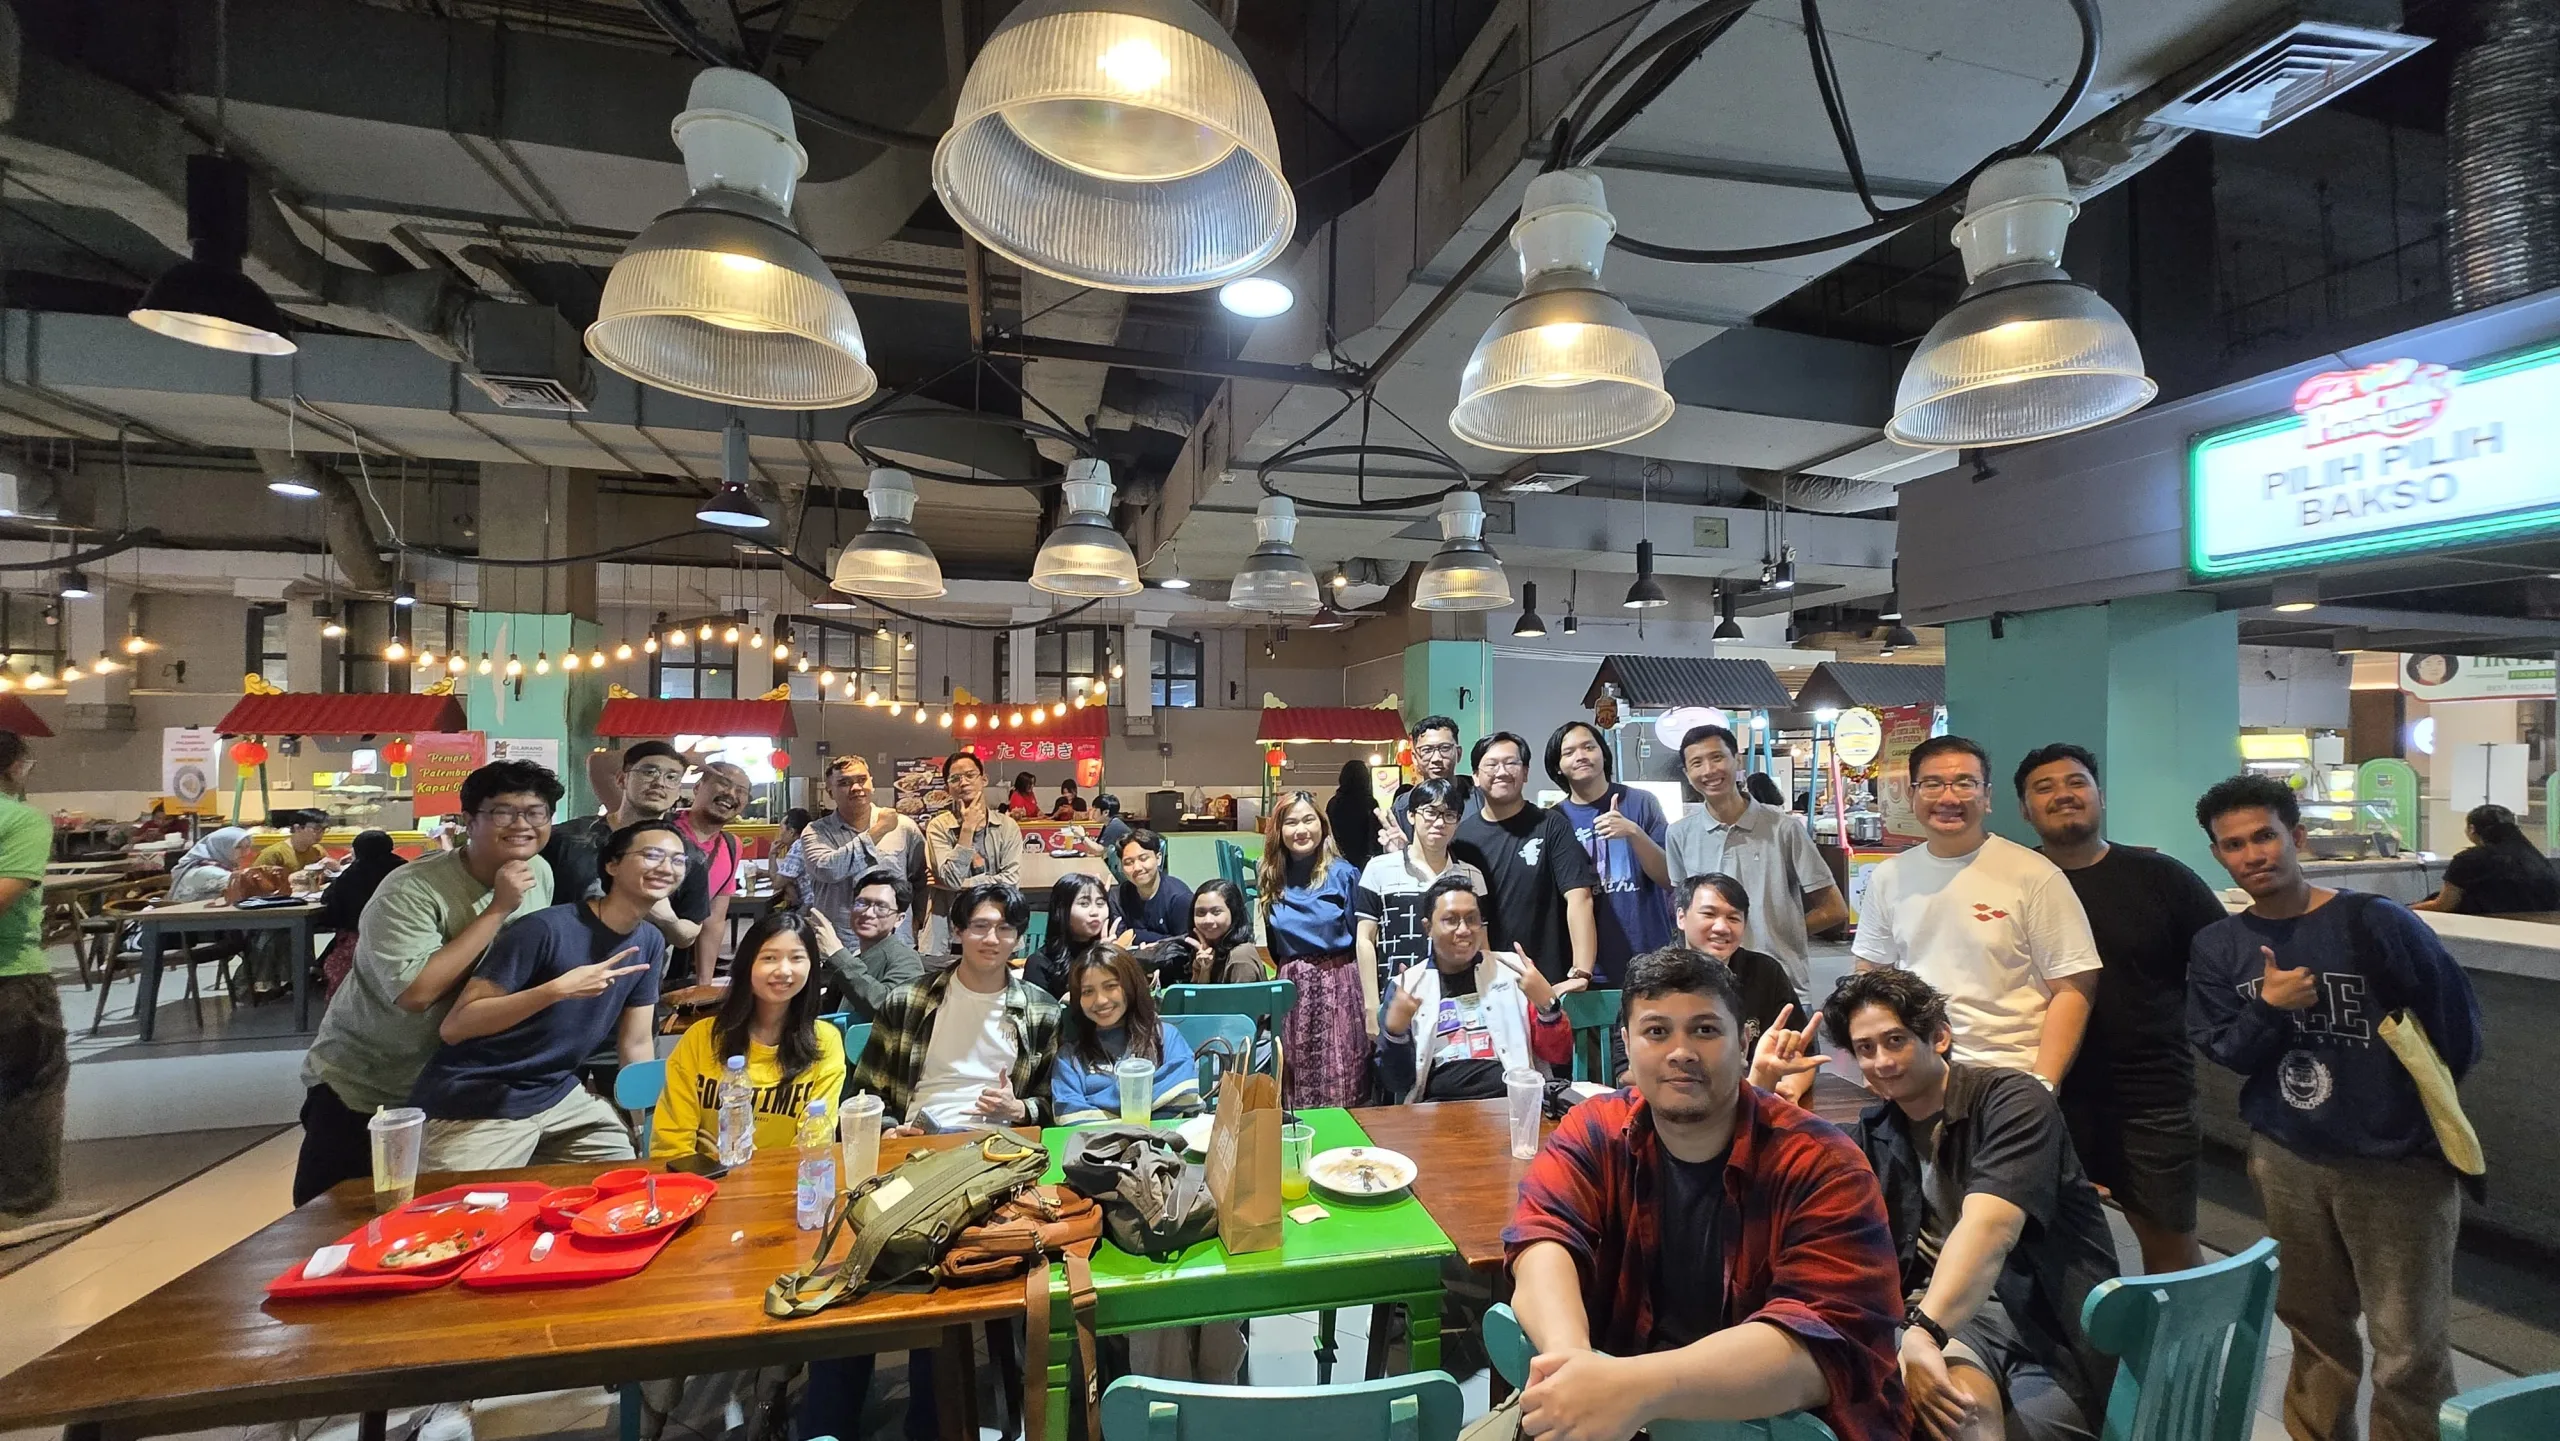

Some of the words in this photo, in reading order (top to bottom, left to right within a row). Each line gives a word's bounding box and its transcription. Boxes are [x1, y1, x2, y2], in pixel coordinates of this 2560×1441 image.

[2263, 452, 2363, 500] PILIH
[2380, 422, 2505, 475] PILIH
[2300, 474, 2457, 526] BAKSO
[427, 752, 471, 764] Pempek
[996, 740, 1074, 760] たこ焼き
[419, 768, 473, 778] Palemban
[415, 782, 450, 794] Kapal
